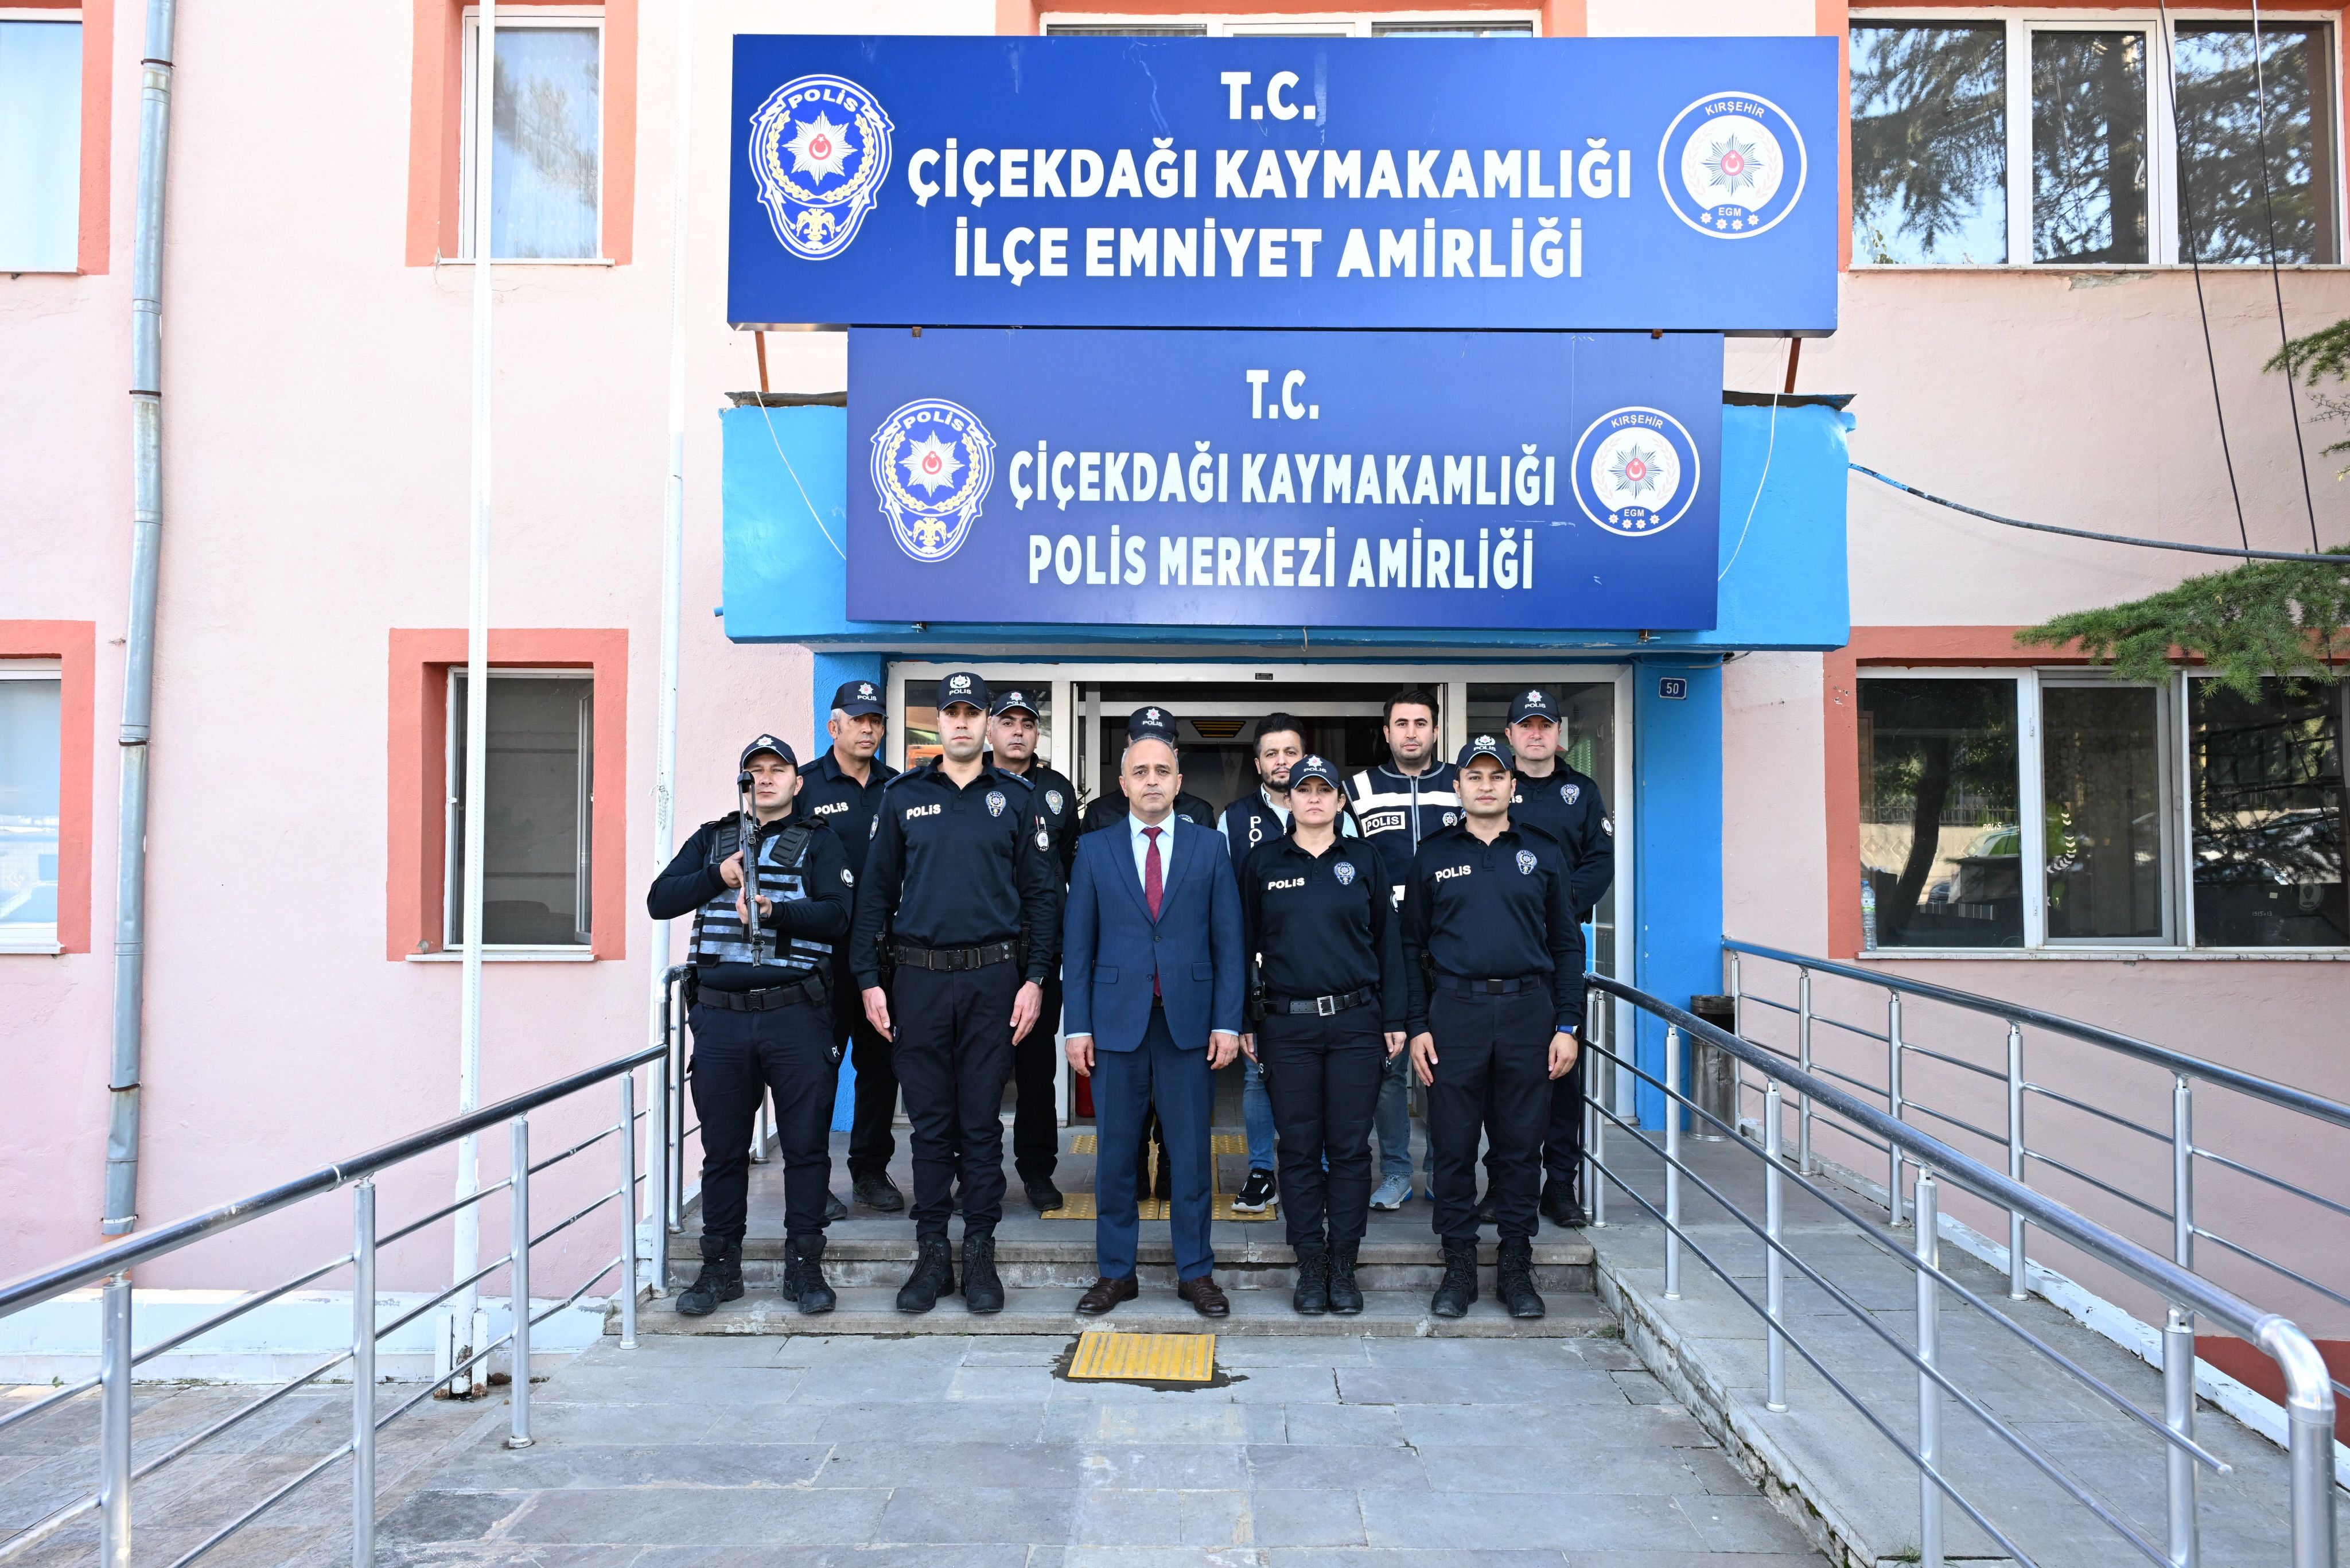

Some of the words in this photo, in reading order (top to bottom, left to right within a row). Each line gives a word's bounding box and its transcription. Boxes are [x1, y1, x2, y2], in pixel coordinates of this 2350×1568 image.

[1221, 71, 1316, 120] T.C.
[1705, 101, 1765, 118] KIRŞEHİR
[909, 138, 1196, 207] ÇİÇEKDAĞI
[1216, 138, 1630, 199] KAYMAKAMLIĞI
[1718, 207, 1742, 216] EGM
[956, 217, 1068, 286] İLÇE
[1086, 218, 1321, 277] EMNİYET
[1337, 217, 1582, 278] AMİRLİĞİ
[1247, 370, 1318, 419] T.C.
[1611, 414, 1663, 429] KIRŞEHİR
[1010, 441, 1228, 511] ÇİÇEKDAĞI
[1242, 444, 1554, 505] KAYMAKAMLIĞI
[1030, 525, 1146, 585] POLİS
[1160, 527, 1334, 586] MERKEZİ
[1348, 528, 1532, 589] AMİRLİĞİ
[1666, 683, 1679, 694] 50
